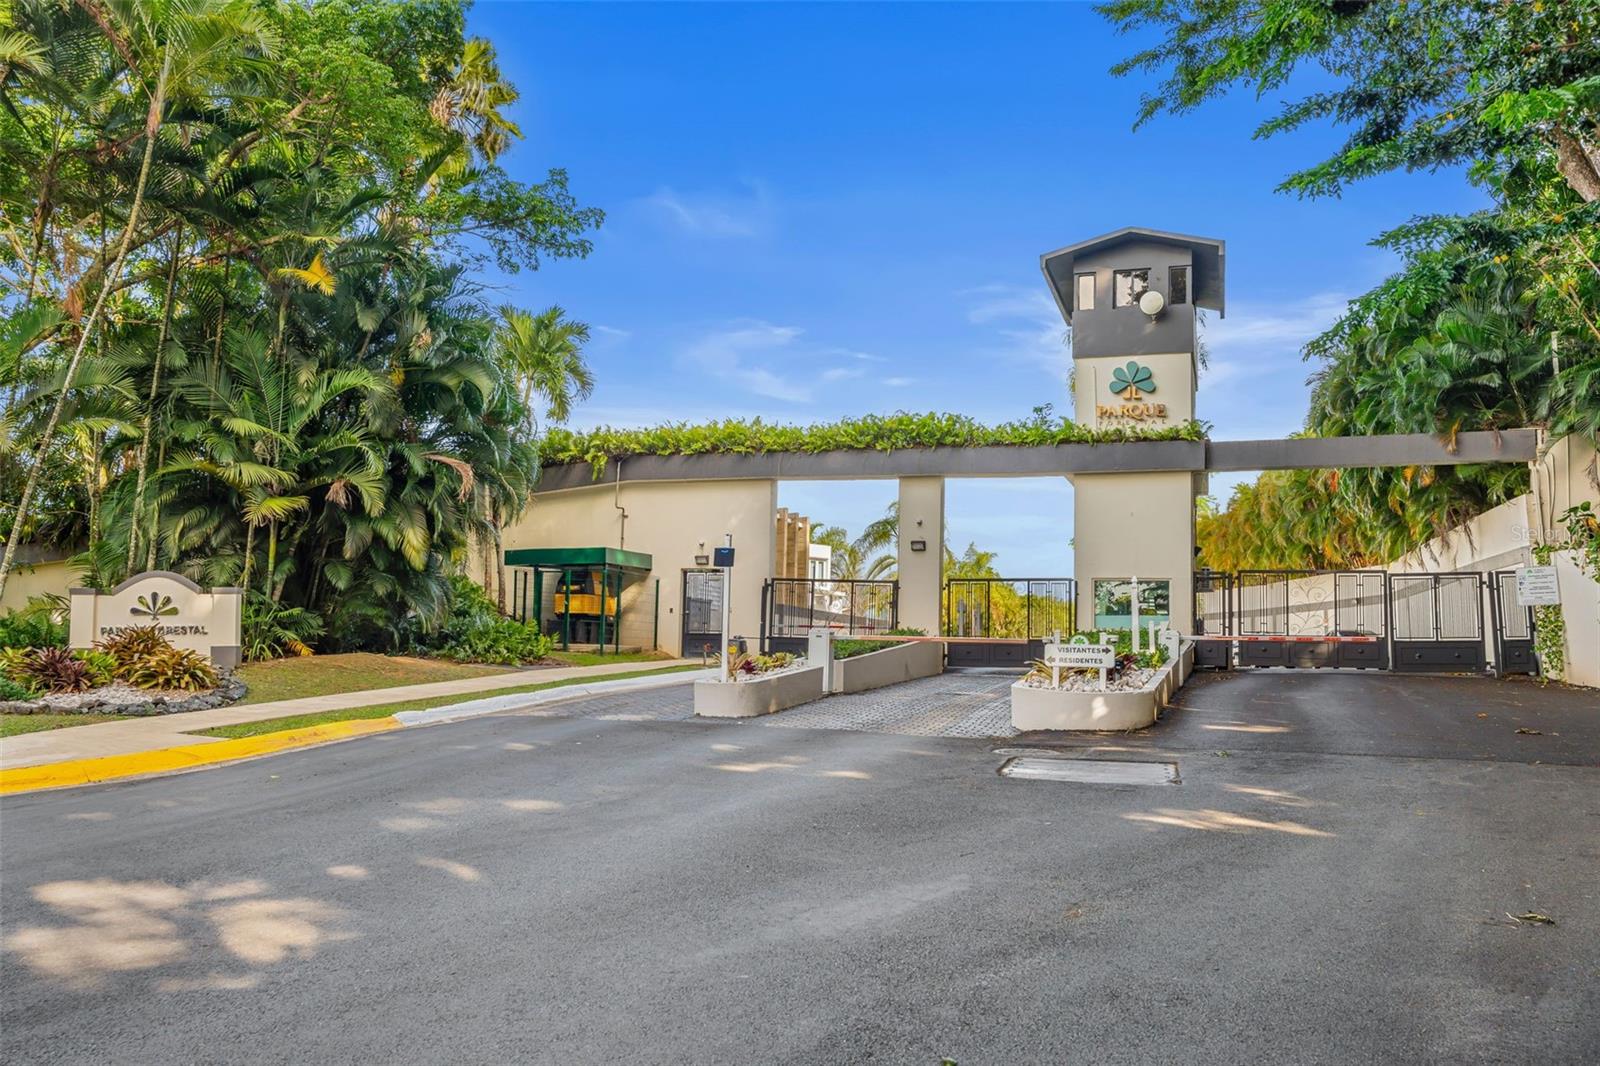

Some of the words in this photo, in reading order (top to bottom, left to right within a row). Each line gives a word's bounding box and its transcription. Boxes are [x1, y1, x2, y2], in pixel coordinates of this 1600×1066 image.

[1096, 403, 1167, 421] PARQUE
[1057, 646, 1101, 654] VISITANTES
[1058, 656, 1104, 665] RESIDENTES
